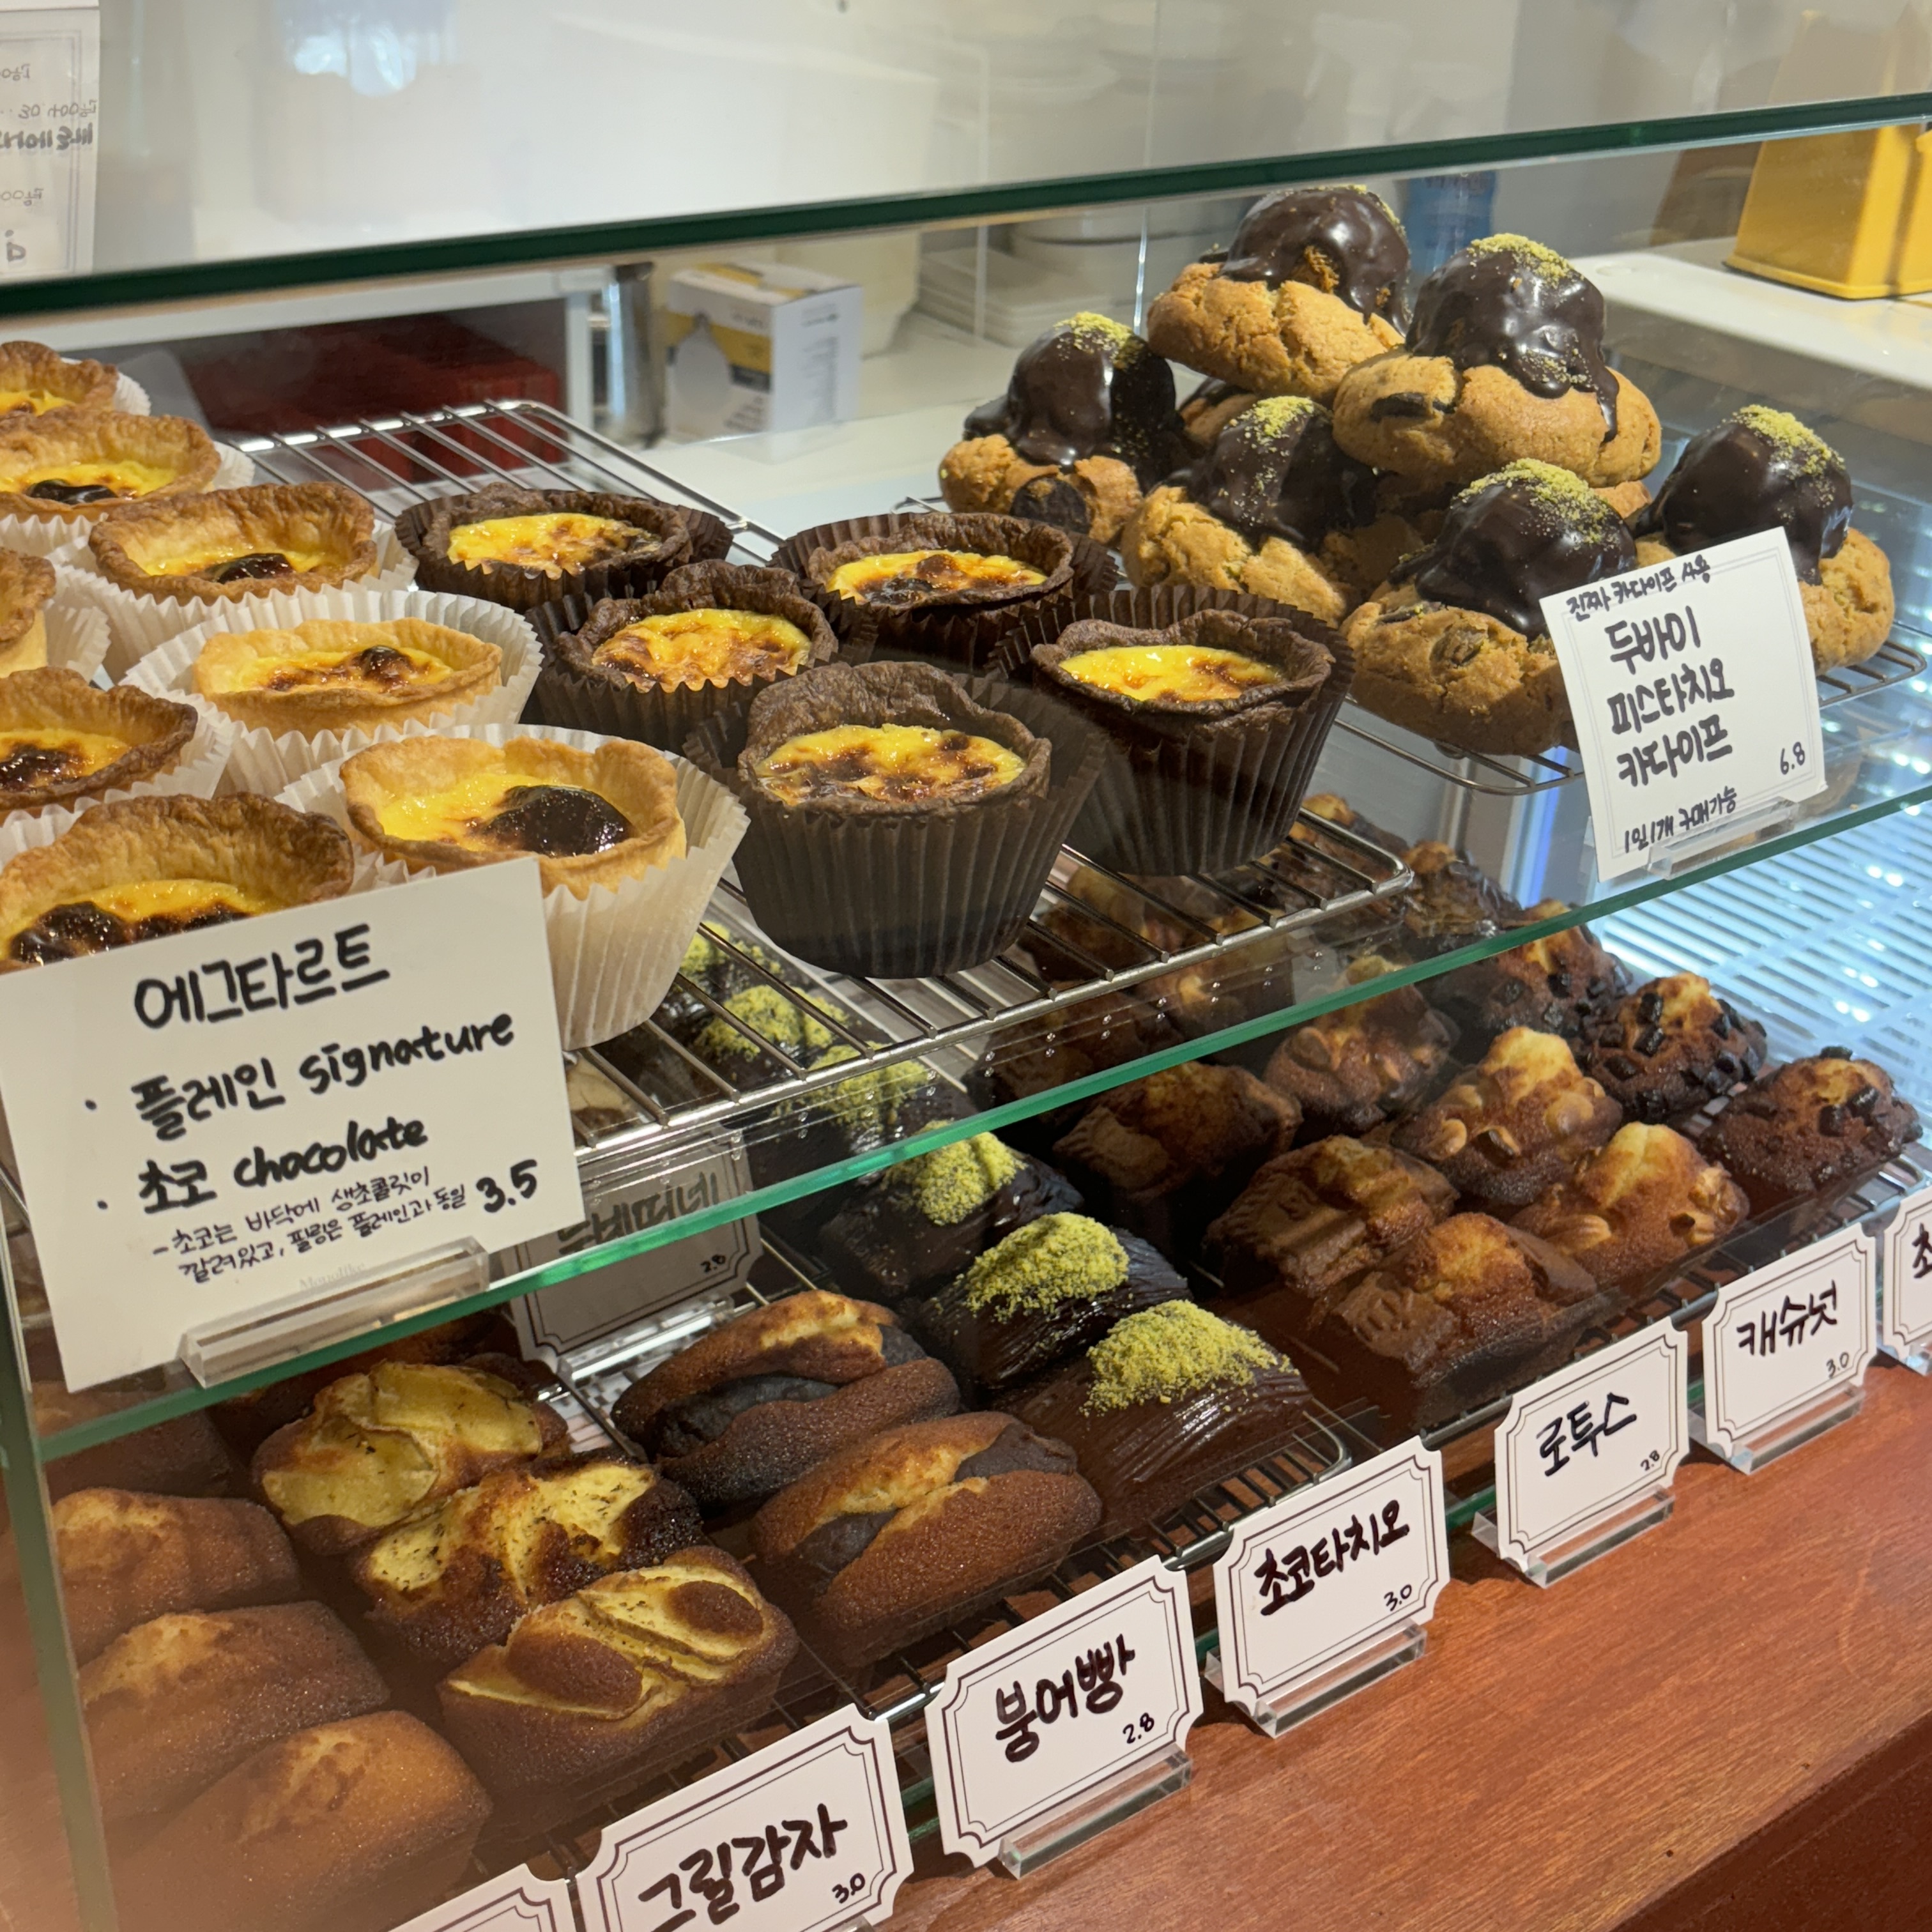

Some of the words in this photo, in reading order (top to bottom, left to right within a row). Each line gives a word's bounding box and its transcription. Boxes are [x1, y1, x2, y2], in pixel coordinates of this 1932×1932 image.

[1567, 587, 1611, 622] 진짜
[1611, 567, 1677, 604] 카다이프
[1682, 554, 1710, 583] 사용
[1605, 606, 1701, 675] 두바이
[1607, 658, 1735, 735] 피스타치오
[1617, 714, 1733, 786] 카다이프
[1781, 742, 1805, 775] 6.8
[1678, 786, 1737, 832] 구매가능
[134, 924, 390, 1029] 에그타르트
[131, 1057, 286, 1141] 플레인
[299, 1013, 514, 1094] signature
[139, 1160, 217, 1214] 초코
[234, 1117, 428, 1187] chocolate
[245, 1197, 320, 1232] 바닥에
[331, 1165, 429, 1211] 생초콜릿이
[476, 1159, 537, 1213] 3.5
[287, 1220, 342, 1254] 필링은
[348, 1199, 433, 1238] 플레인과
[433, 1184, 466, 1211] 동일
[1736, 1280, 1837, 1356] 캐슈넛
[1825, 1352, 1850, 1379] 3.0
[1536, 1392, 1637, 1477] 로투스
[1640, 1449, 1660, 1471] 2.8
[1254, 1499, 1410, 1616] 초코타치오
[1383, 1584, 1413, 1611] 3.0
[995, 1633, 1136, 1763] 붕어빵
[1123, 1713, 1155, 1744] 2.8
[638, 1803, 848, 1932] 그릴감자
[832, 1873, 865, 1905] 3.0
